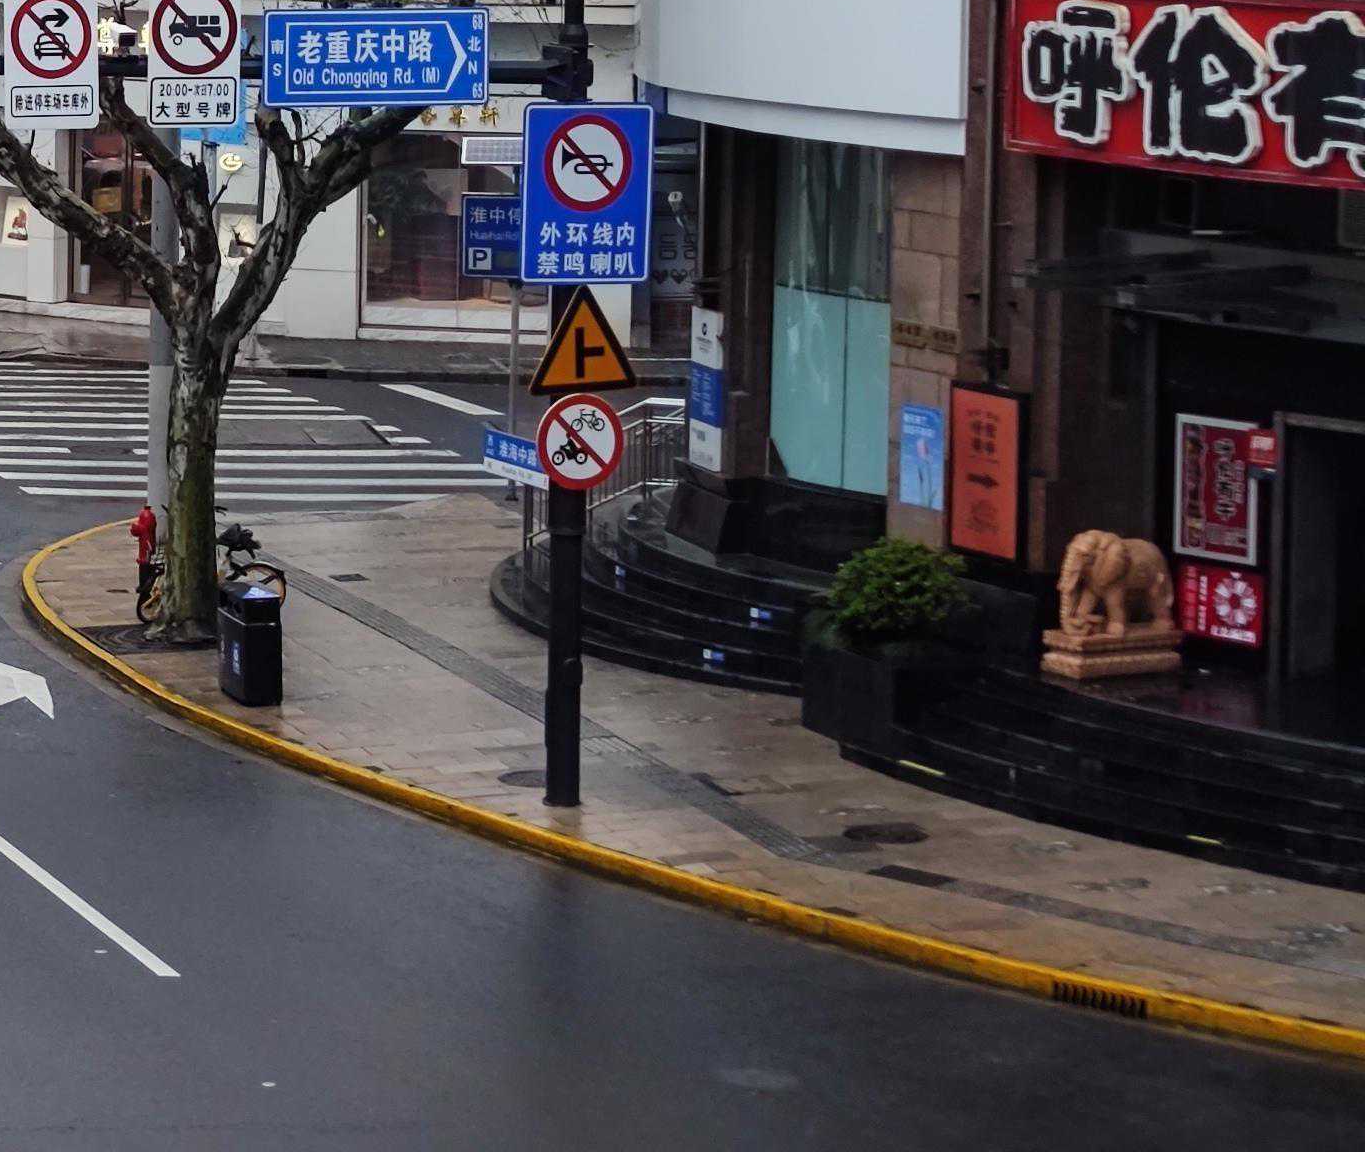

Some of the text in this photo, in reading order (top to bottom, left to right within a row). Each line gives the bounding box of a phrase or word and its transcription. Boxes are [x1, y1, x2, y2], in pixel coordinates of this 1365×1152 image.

[472, 14, 484, 31] 68
[270, 39, 285, 55] 南
[297, 28, 434, 64] 老重庆中路
[467, 36, 482, 53] 北
[272, 63, 282, 77] S
[468, 61, 478, 75] N
[293, 67, 440, 89] Old Chongqing Rd. (M)
[472, 82, 484, 99] 65
[155, 101, 232, 119] 大型号牌
[539, 221, 636, 247] 外环线内
[537, 251, 636, 276] 禁鸣喇叭
